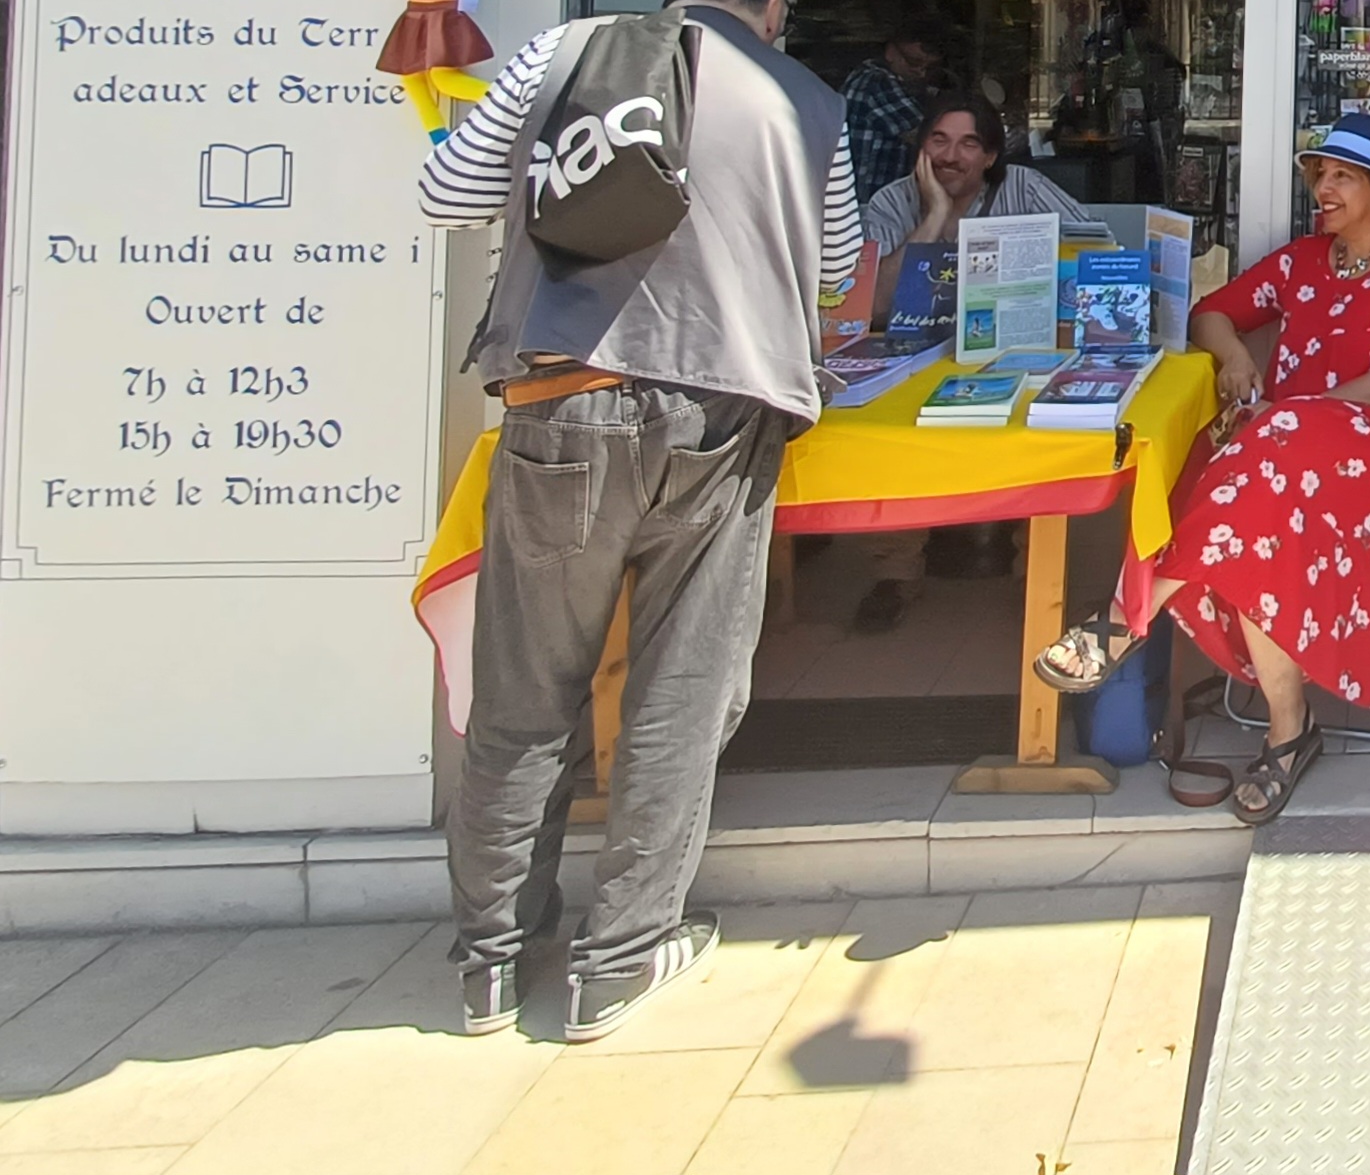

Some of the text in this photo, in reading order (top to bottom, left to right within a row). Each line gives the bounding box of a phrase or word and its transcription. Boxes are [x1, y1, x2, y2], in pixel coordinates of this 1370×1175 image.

[51, 15, 215, 52] Produits
[234, 18, 277, 46] du
[73, 76, 407, 106] adeaux et Service
[45, 235, 98, 264] Du
[119, 235, 211, 264] lundi
[229, 240, 273, 264] au
[145, 296, 325, 325] Ouvert de
[122, 366, 310, 403] 7h à 12h3
[119, 419, 343, 456] 15h à 19h30
[42, 474, 402, 512] Fermé le Dimanche
